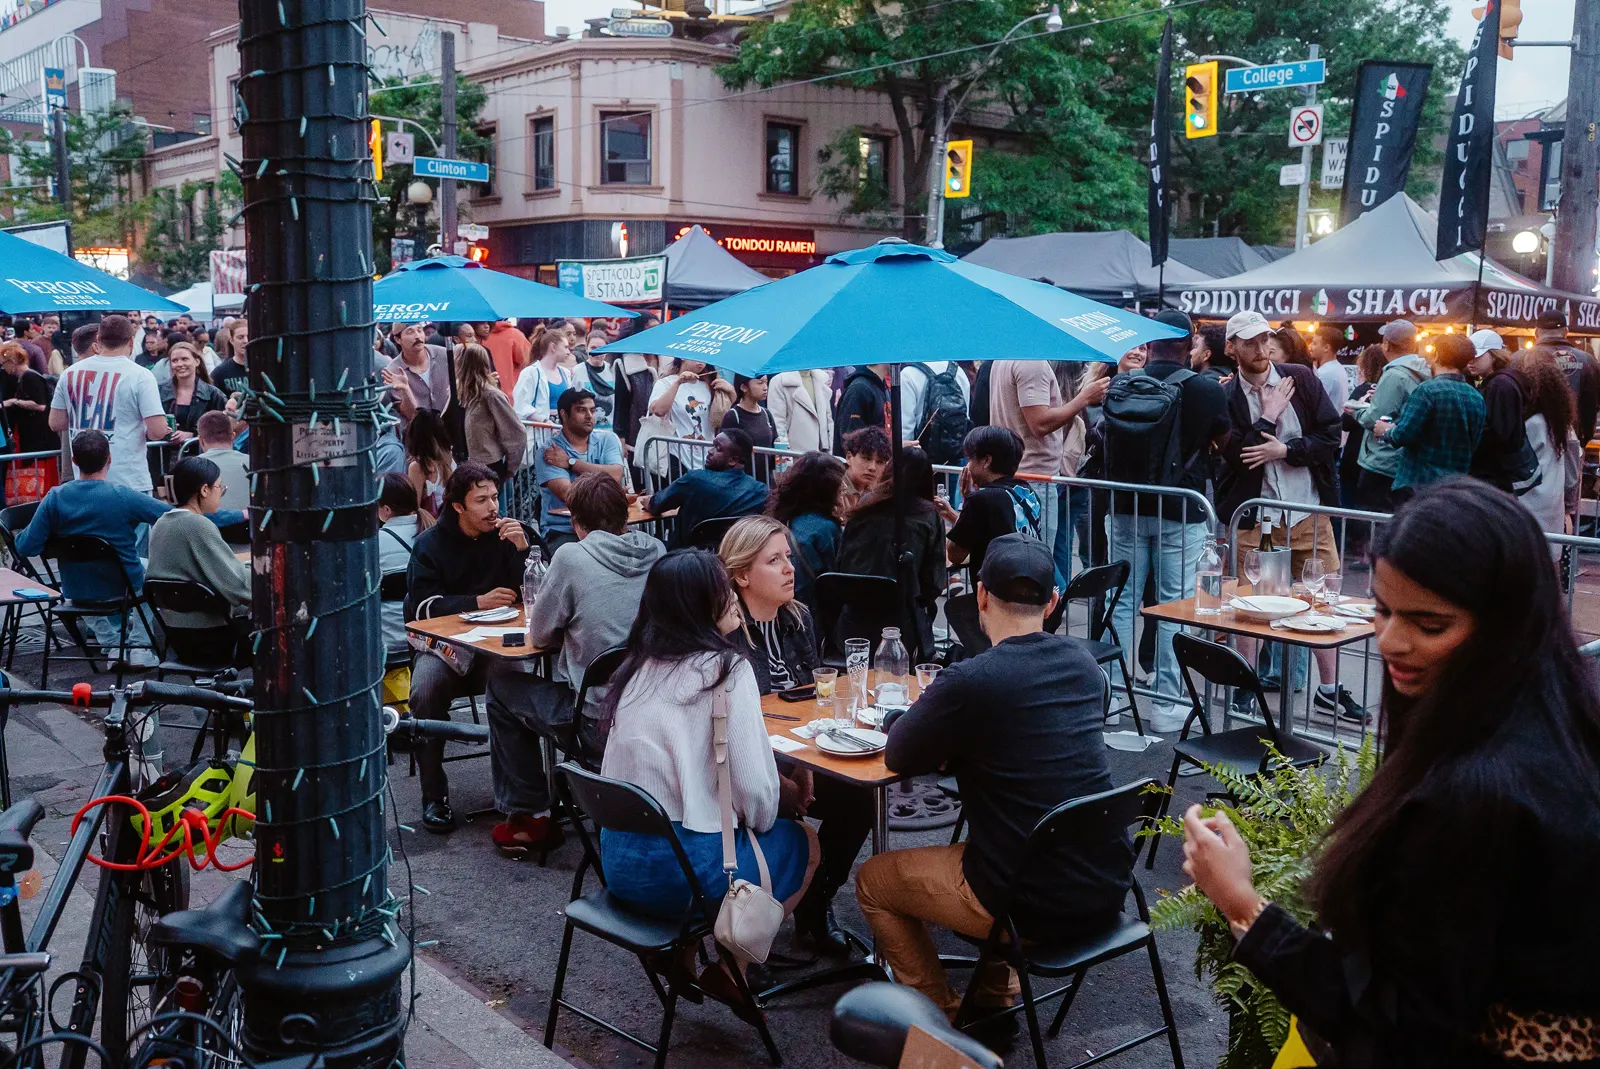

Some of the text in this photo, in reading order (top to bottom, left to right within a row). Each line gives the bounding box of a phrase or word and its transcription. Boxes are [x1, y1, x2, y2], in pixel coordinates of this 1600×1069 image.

[614, 22, 669, 34] PATTISON
[1243, 68, 1294, 85] College
[1329, 142, 1347, 155] TW
[1360, 101, 1396, 206] SPIDU
[427, 160, 467, 176] Clinton
[1328, 159, 1346, 172] WA
[1324, 175, 1345, 185] TRAF
[725, 237, 816, 254] TONDOU RAMEN
[587, 267, 641, 281] SPETTACOLO
[5, 278, 107, 294] PERONI
[597, 282, 641, 298] STRADA
[1179, 288, 1451, 316] SPIDUCCI SHACK
[676, 321, 768, 344] PERONI
[666, 342, 721, 355] AZZURRO
[685, 338, 723, 347] NASTRO
